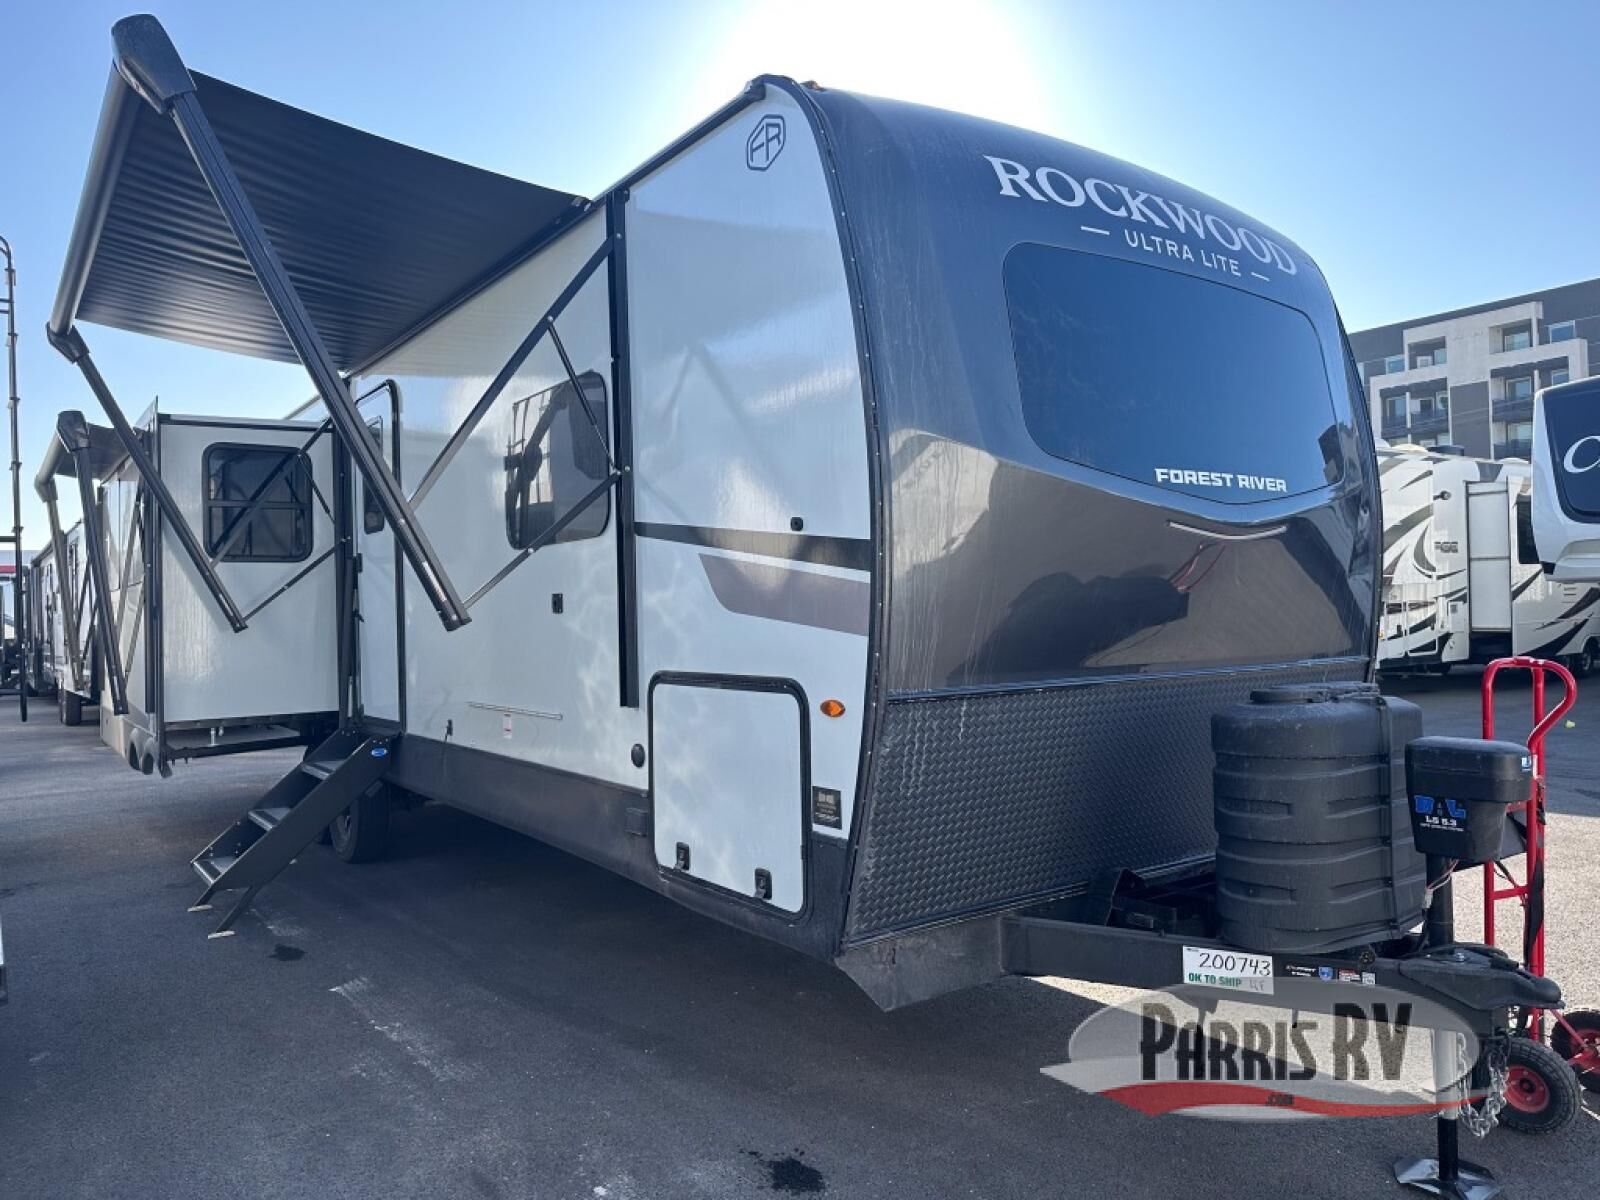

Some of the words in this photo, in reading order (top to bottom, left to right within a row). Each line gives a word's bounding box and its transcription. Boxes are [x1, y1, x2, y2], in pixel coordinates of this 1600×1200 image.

[983, 154, 1298, 276] ROCKWOOD
[1124, 228, 1194, 263] ULTRA
[1201, 249, 1242, 277] LITE
[1154, 467, 1234, 488] FOREST
[1236, 474, 1288, 493] RIVER
[1199, 952, 1272, 977] 200743
[1188, 972, 1202, 984] OK
[1204, 974, 1217, 985] TO
[1218, 976, 1242, 988] SHIP
